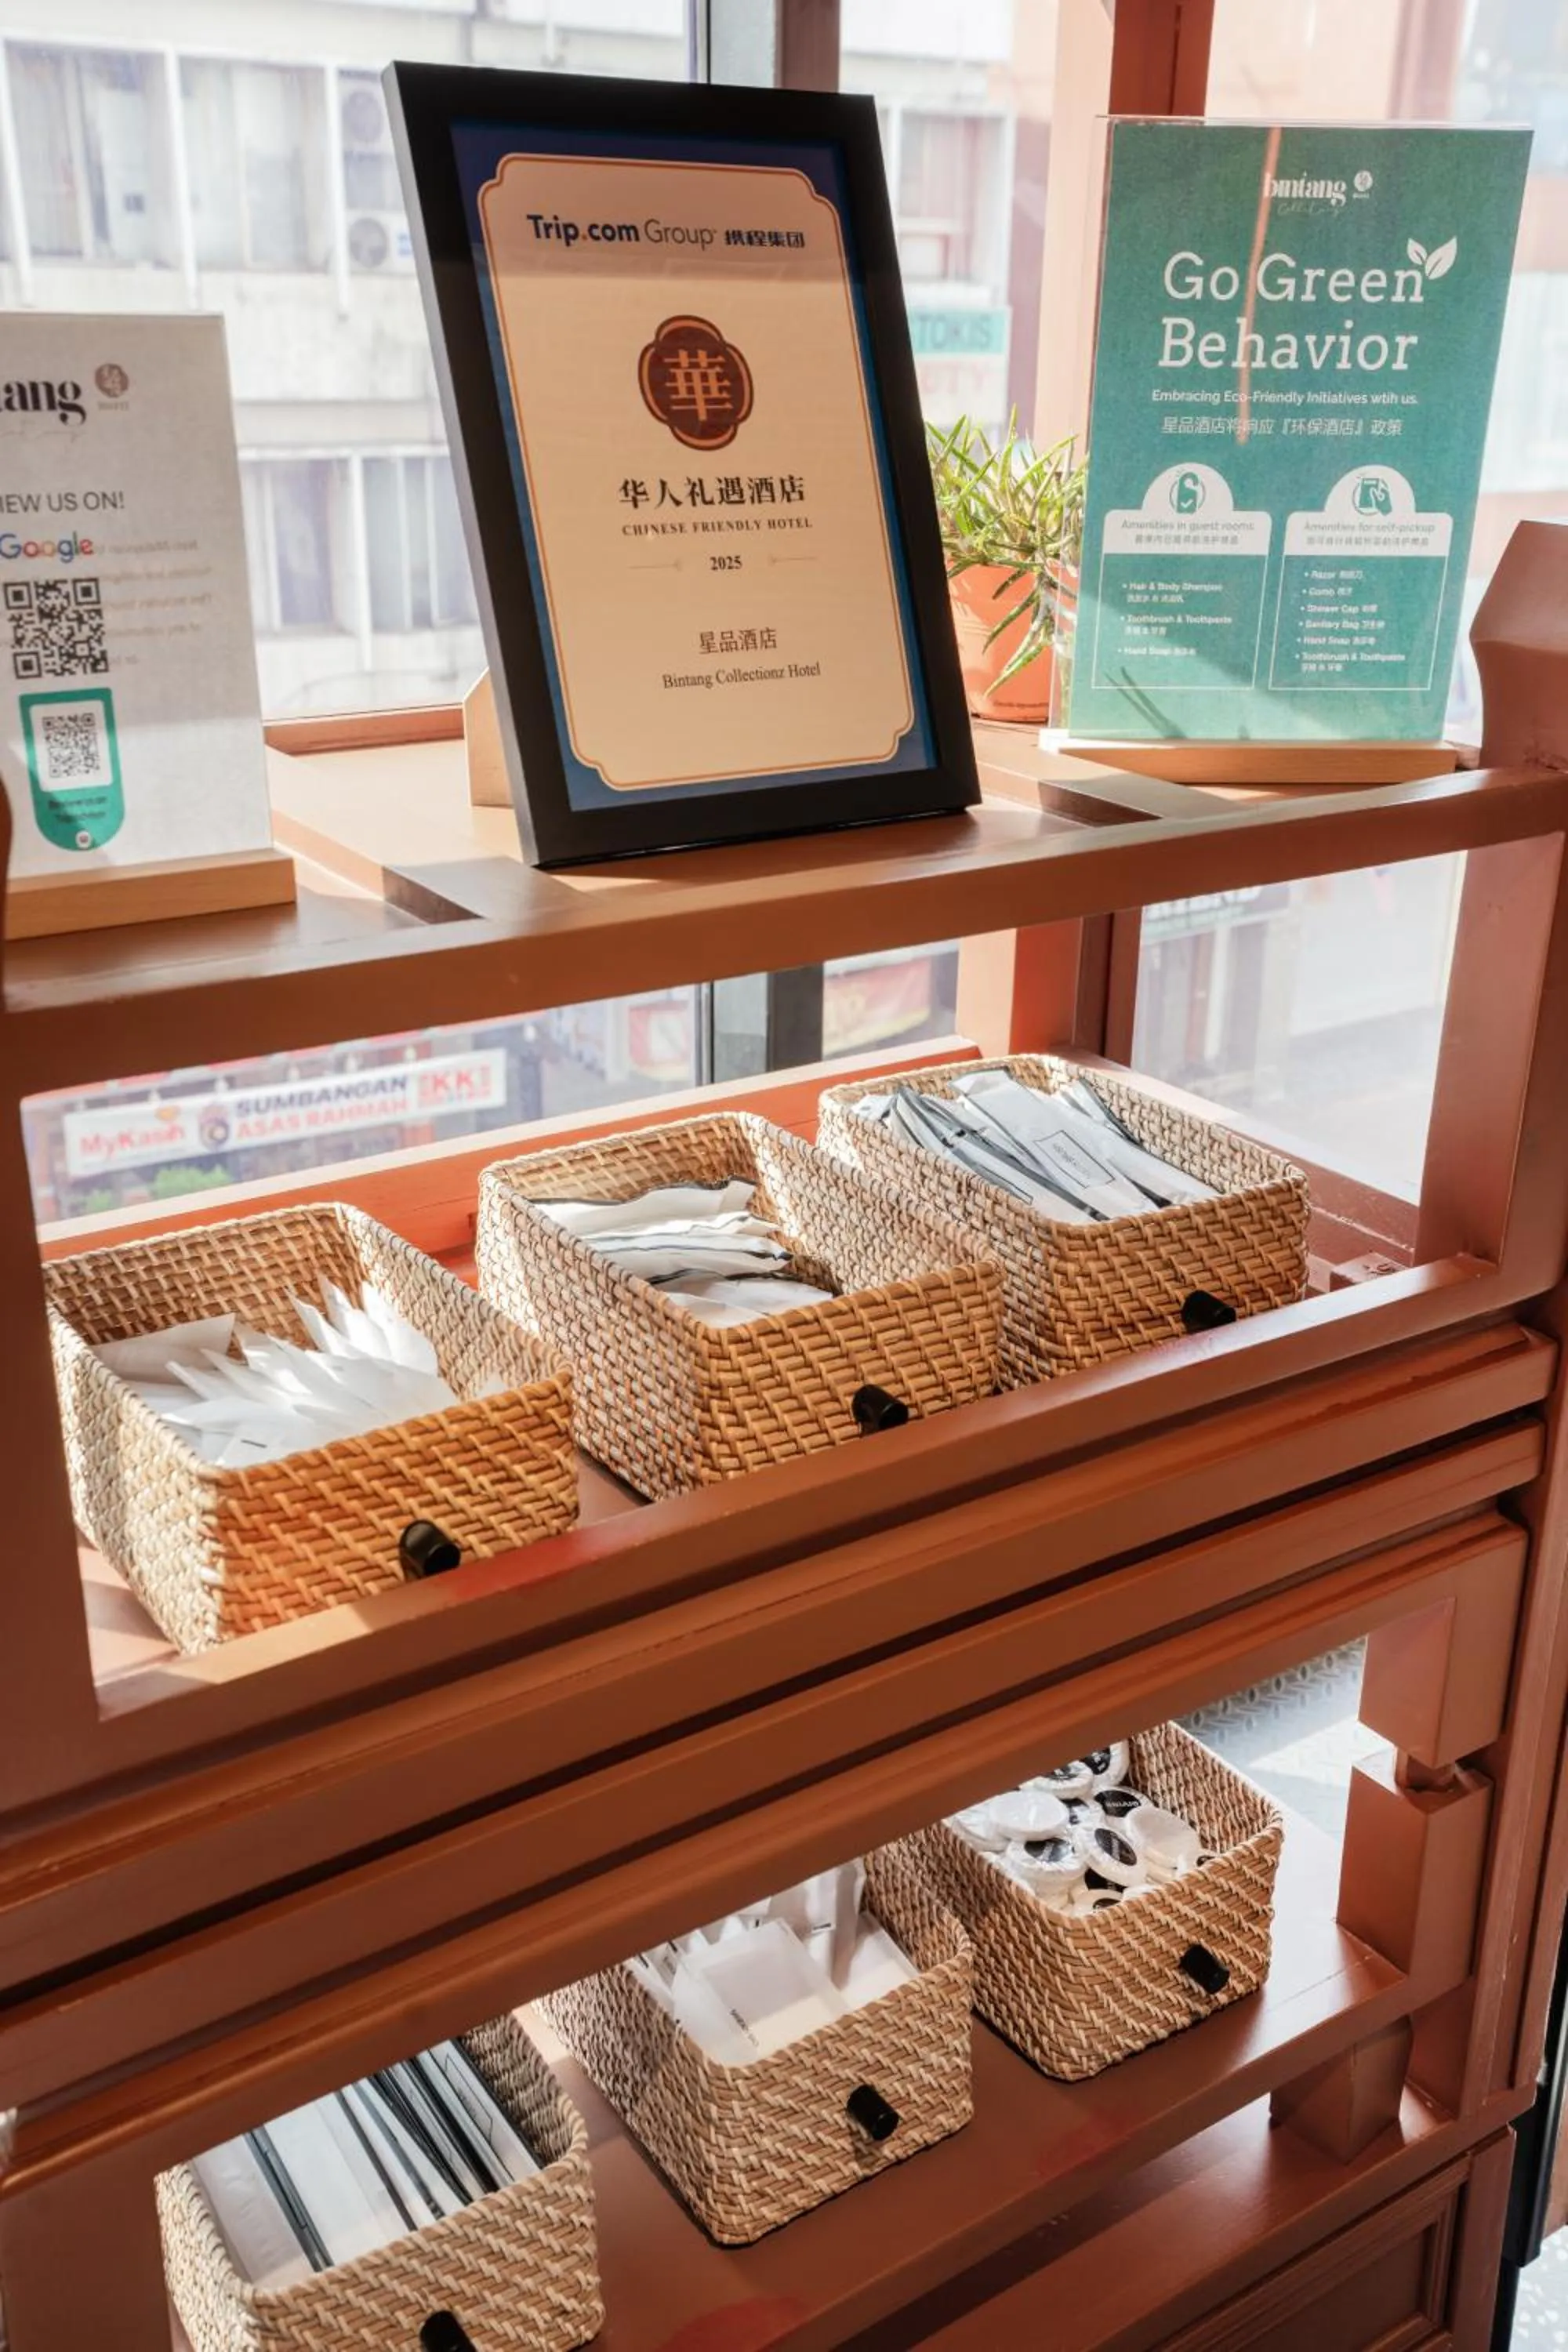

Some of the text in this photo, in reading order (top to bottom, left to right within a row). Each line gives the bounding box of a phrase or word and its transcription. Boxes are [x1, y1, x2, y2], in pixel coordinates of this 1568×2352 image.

[526, 214, 715, 251] Trip.com Group
[724, 229, 805, 249] 携程集团
[1163, 251, 1425, 303] Go Green
[1157, 316, 1418, 370] Behavior
[663, 349, 734, 421] 華
[1152, 389, 1221, 405] Embracing
[1224, 390, 1304, 405] Eco-Friendly
[1307, 391, 1368, 405] Initiatives
[47, 492, 78, 513] US
[83, 490, 125, 510] ON!
[619, 474, 805, 510] 华人礼遇酒店
[622, 516, 813, 536] CHINESE FRIENDLY HOTEL
[1122, 520, 1174, 530] Amenities
[1178, 520, 1186, 530] in
[1190, 521, 1219, 532] guest
[1304, 521, 1355, 532] Amenities
[0, 531, 94, 563] Google
[710, 556, 743, 571] 2025
[699, 627, 777, 655] 星品酒店
[662, 661, 821, 689] Bintang Collectionz Hotel
[235, 1075, 408, 1118] SUMBANGAN
